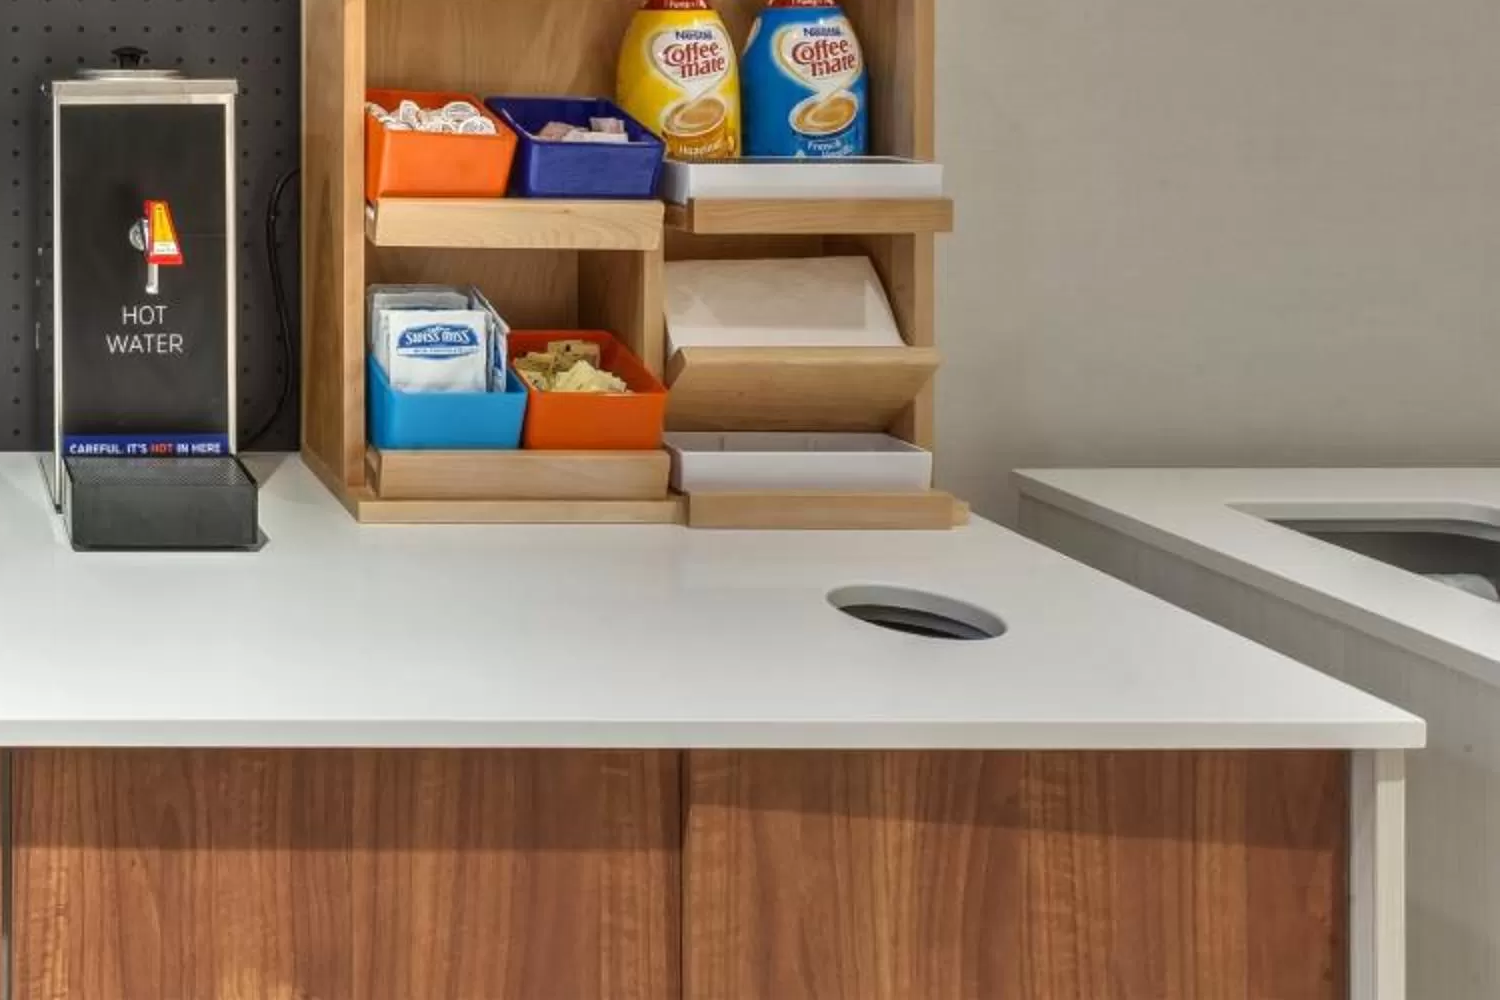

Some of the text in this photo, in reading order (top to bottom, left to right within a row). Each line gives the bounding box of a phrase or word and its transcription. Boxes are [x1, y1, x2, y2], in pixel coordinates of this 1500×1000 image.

[680, 56, 726, 78] mate
[810, 54, 855, 77] mate
[122, 305, 168, 326] HOT
[105, 333, 184, 354] WATER
[126, 442, 148, 454] IT'S
[151, 442, 173, 454] HOT
[176, 443, 189, 454] IN
[191, 442, 222, 454] HERE
